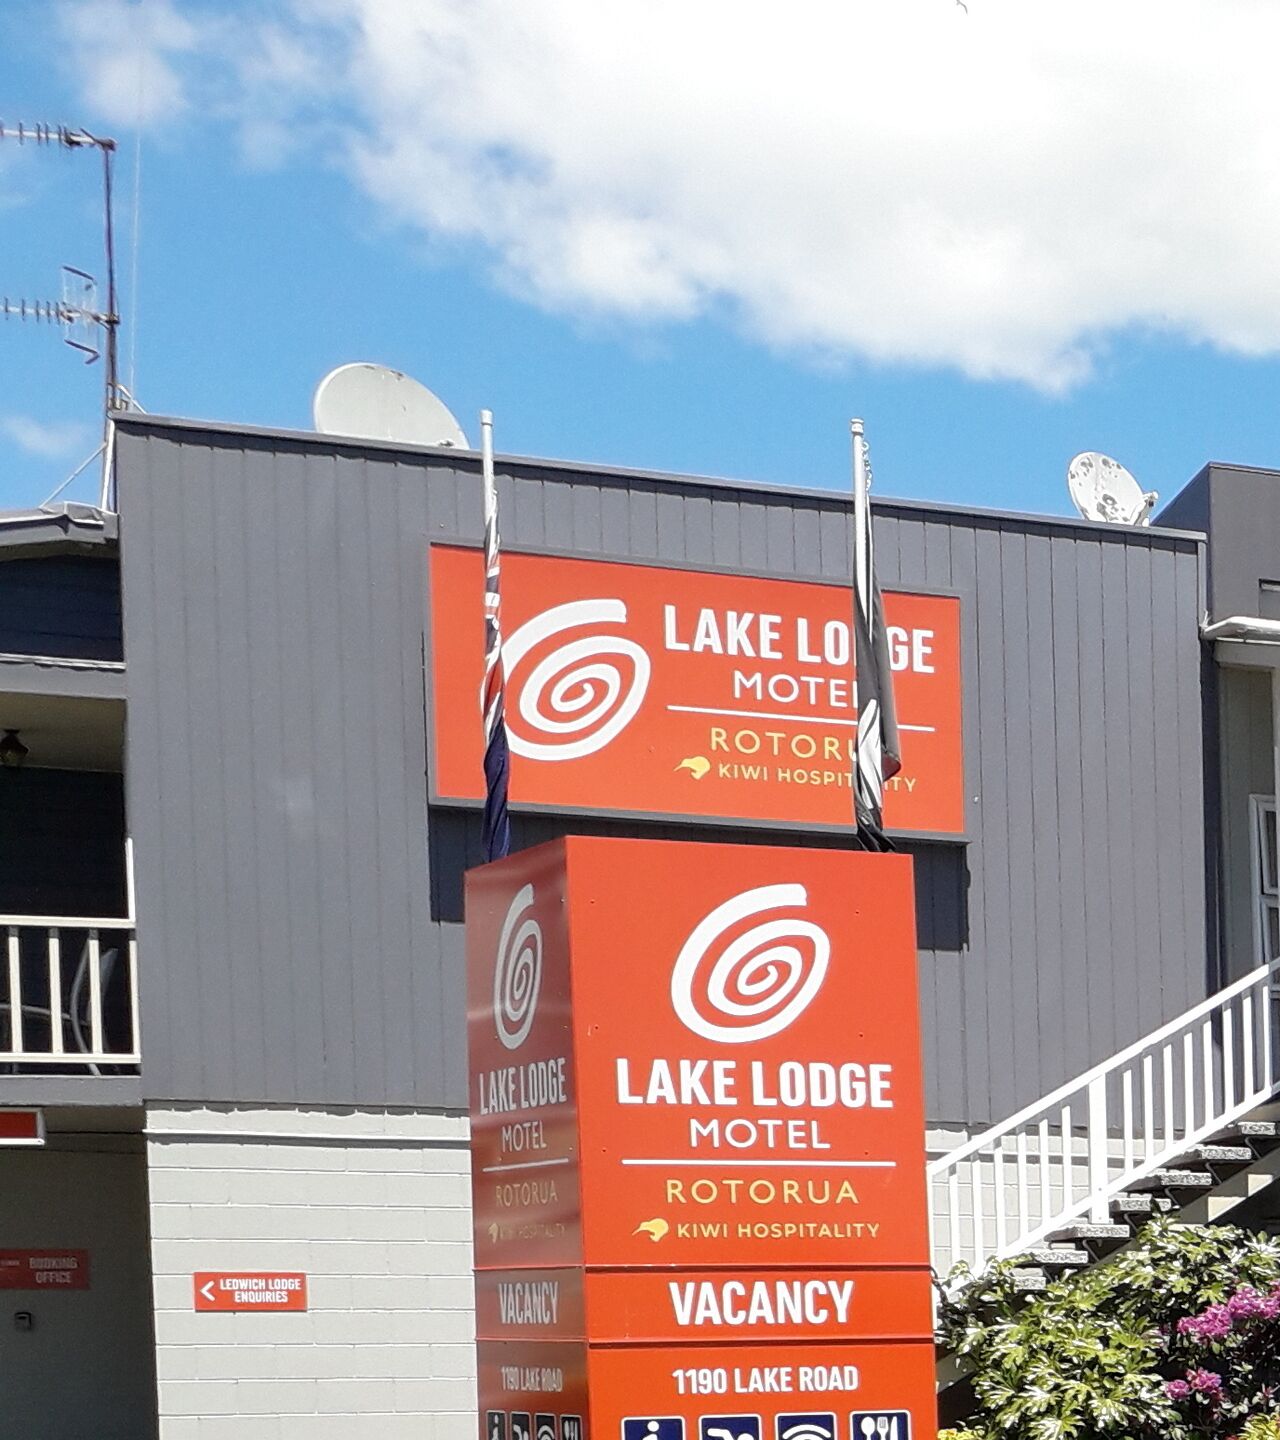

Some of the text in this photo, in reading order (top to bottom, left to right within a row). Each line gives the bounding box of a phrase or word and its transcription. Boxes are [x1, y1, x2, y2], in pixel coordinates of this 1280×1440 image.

[664, 604, 935, 674] LAKE LOGE
[711, 727, 858, 762] ROTOR
[718, 763, 917, 792] KIWI HOSPITITY
[479, 1057, 567, 1116] LAKE LODGE
[616, 1058, 893, 1108] LAKE LODGE
[502, 1120, 547, 1152] MOTEL
[690, 1118, 831, 1149] MOTEL
[495, 1180, 558, 1207] ROTORUA
[666, 1179, 859, 1204] ROTORUA
[677, 1223, 880, 1240] KIWI HOSPITALITY
[269, 1279, 301, 1290] LODGE
[499, 1281, 558, 1324] VACANCY
[669, 1280, 854, 1326] VACANCY
[672, 1366, 858, 1395] 1190 LAKE ROAD
